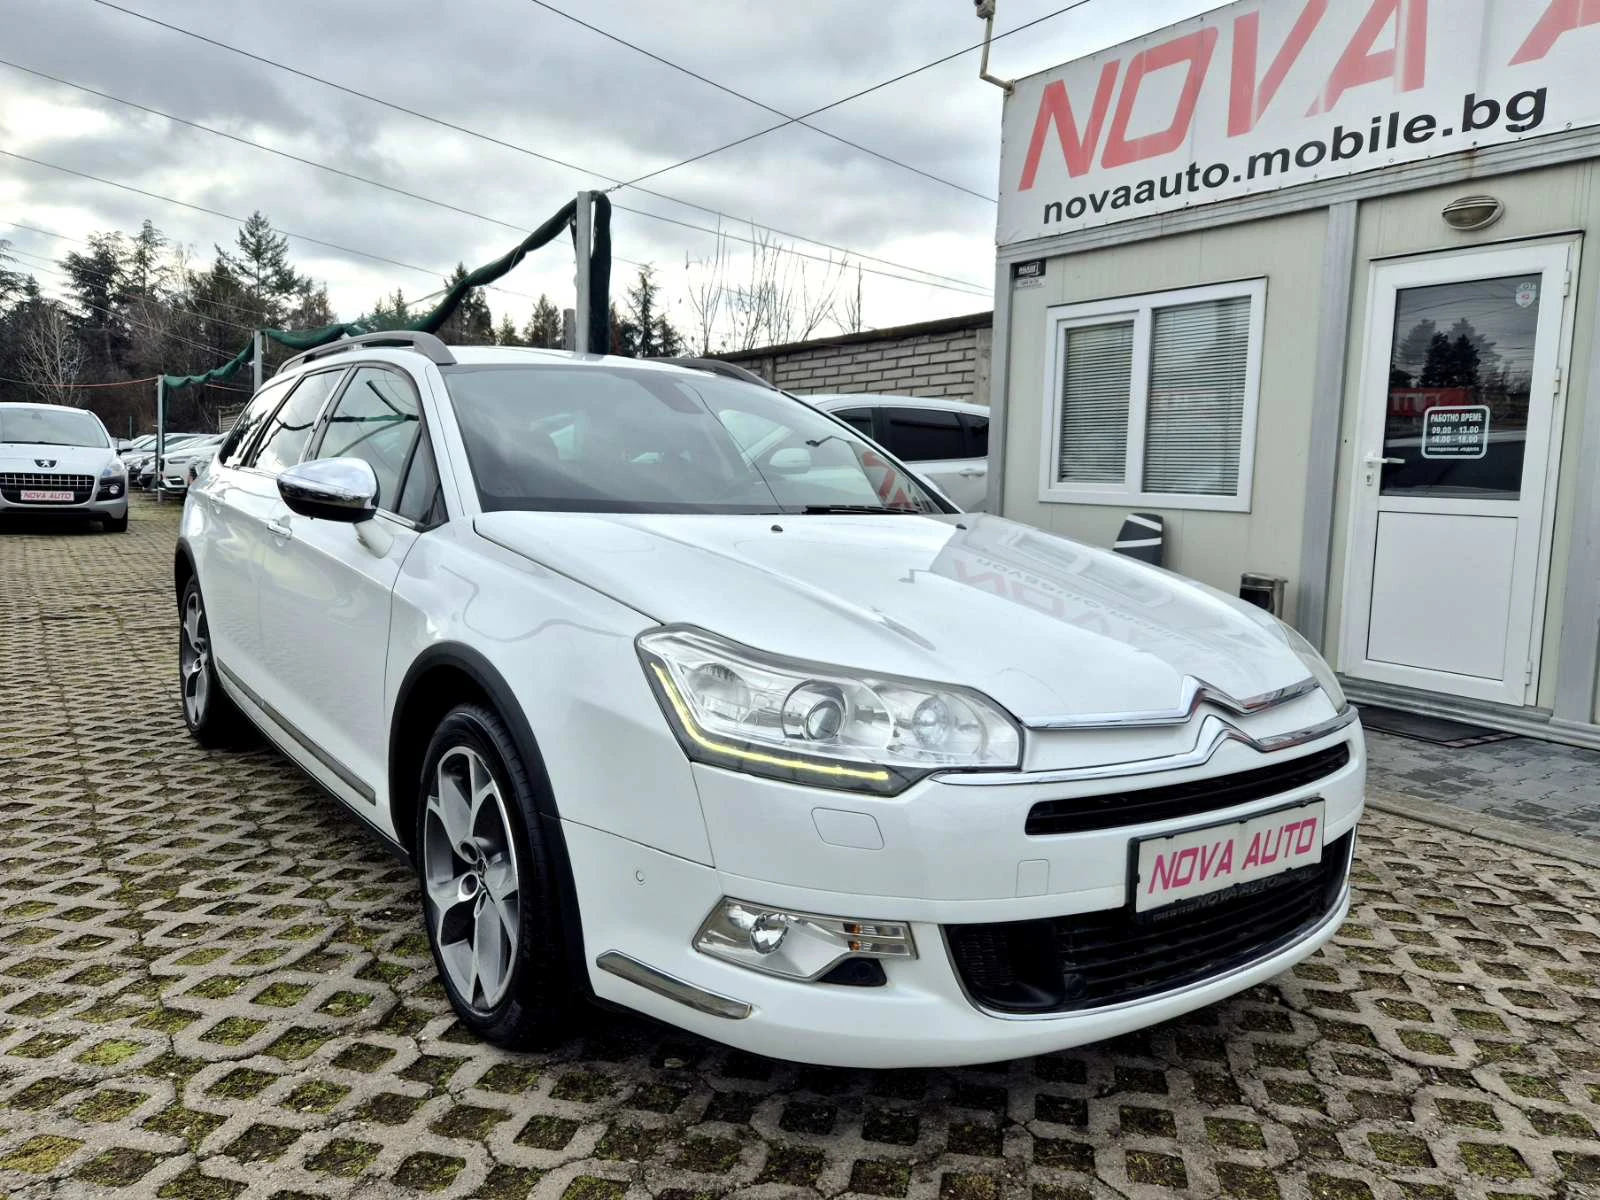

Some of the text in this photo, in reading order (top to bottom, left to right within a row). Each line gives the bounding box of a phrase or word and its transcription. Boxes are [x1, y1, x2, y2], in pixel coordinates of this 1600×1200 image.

[1043, 87, 1547, 224] novaauto.mobile.bg
[1431, 413, 1459, 422] РАБОТНО
[1148, 817, 1317, 894] NOVA AUTO
